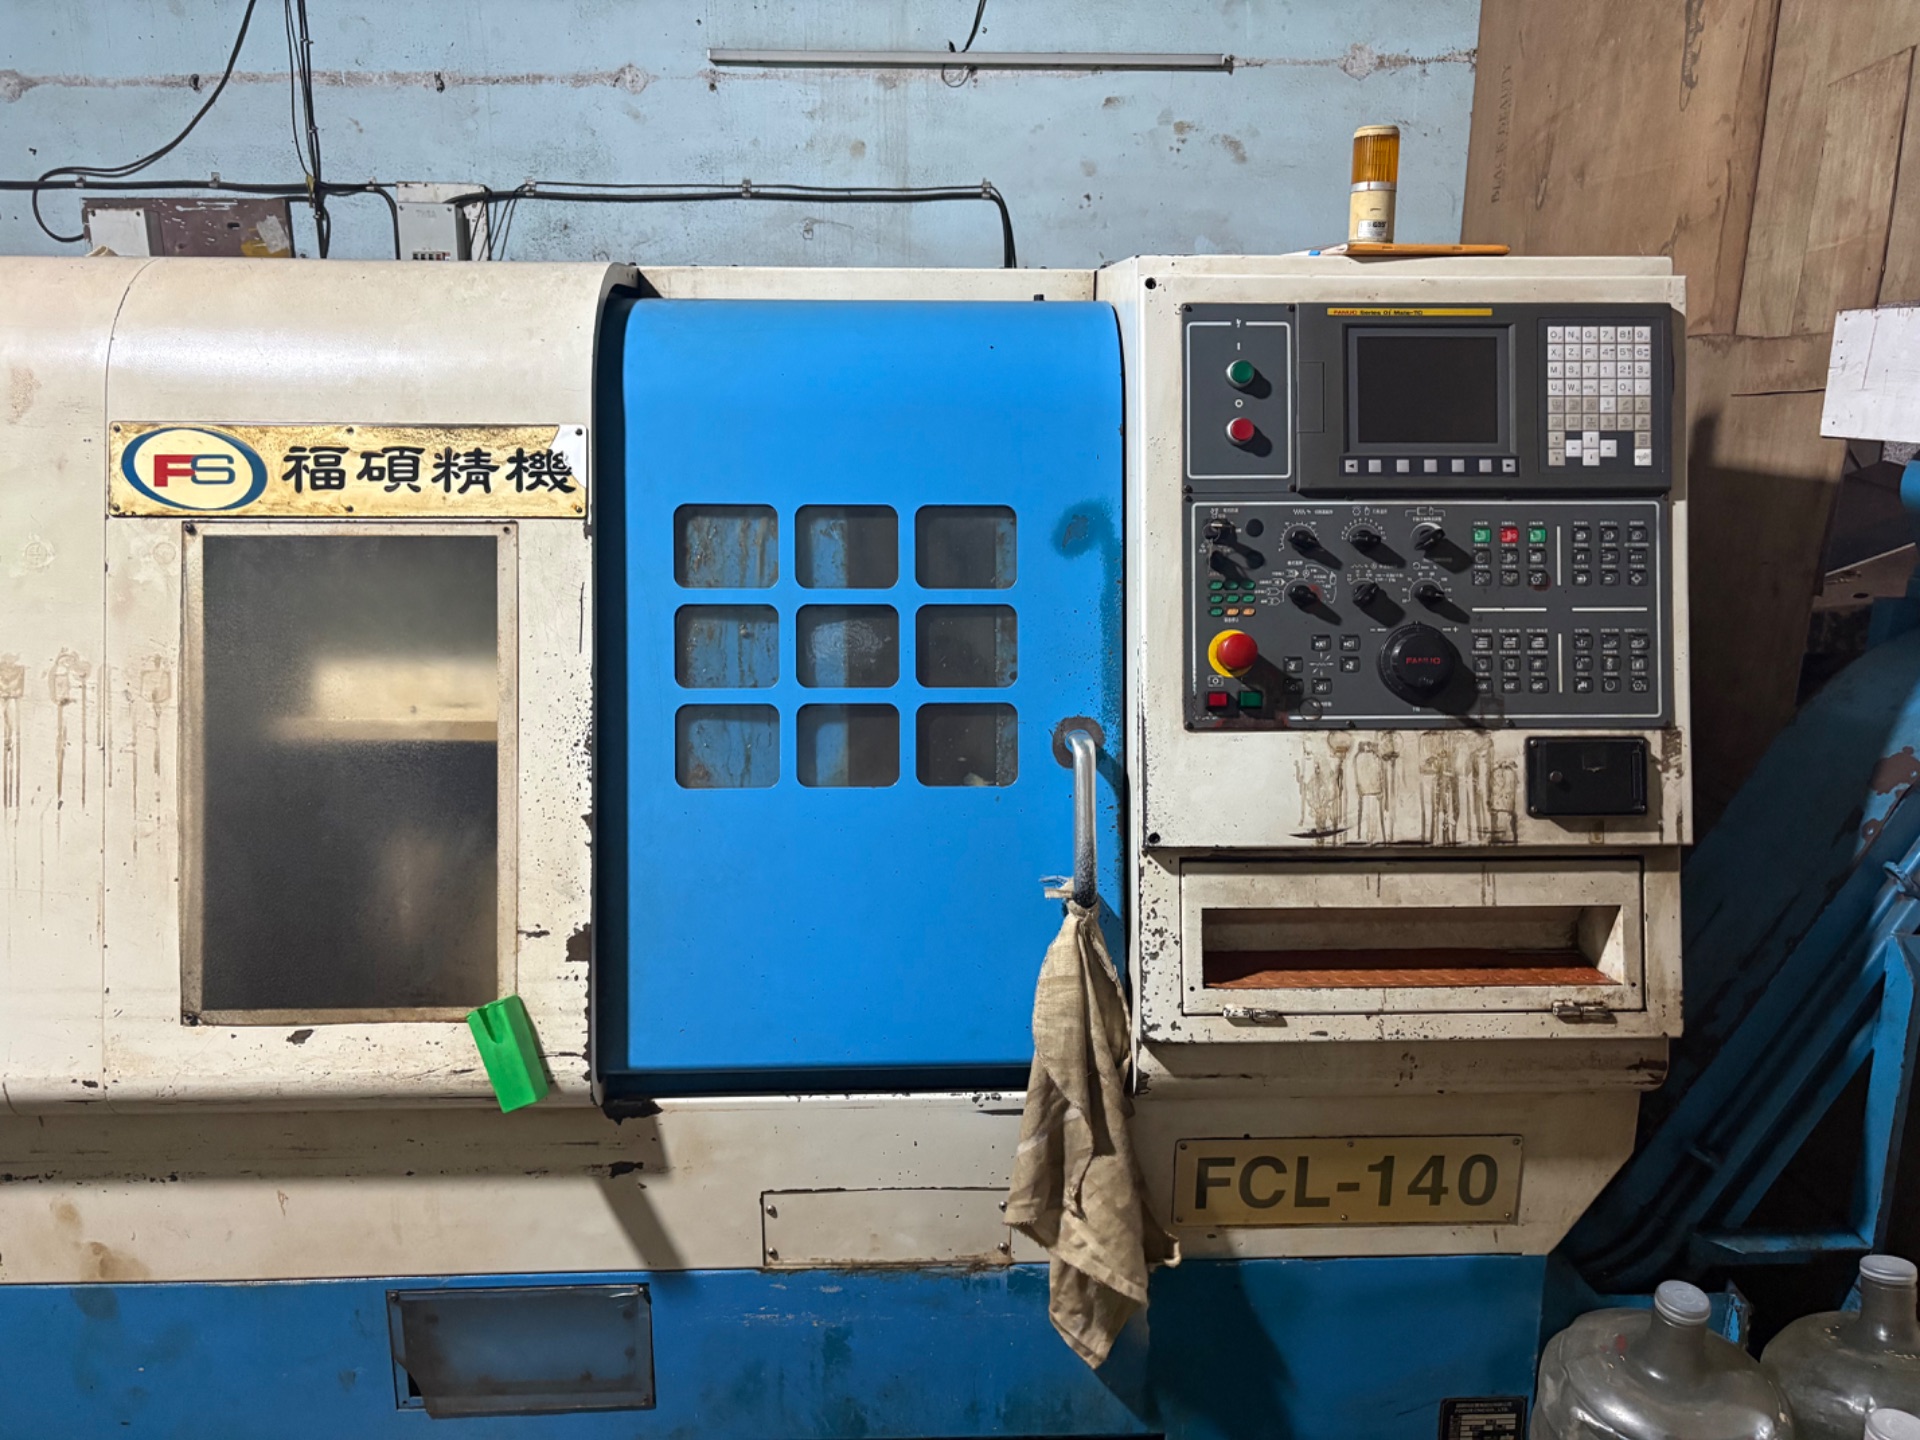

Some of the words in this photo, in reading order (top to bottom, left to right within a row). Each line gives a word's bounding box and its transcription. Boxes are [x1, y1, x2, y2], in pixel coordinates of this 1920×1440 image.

[1360, 309, 1382, 317] Series
[281, 445, 577, 494] 福碩精機
[1194, 1153, 1499, 1210] FCL-140
